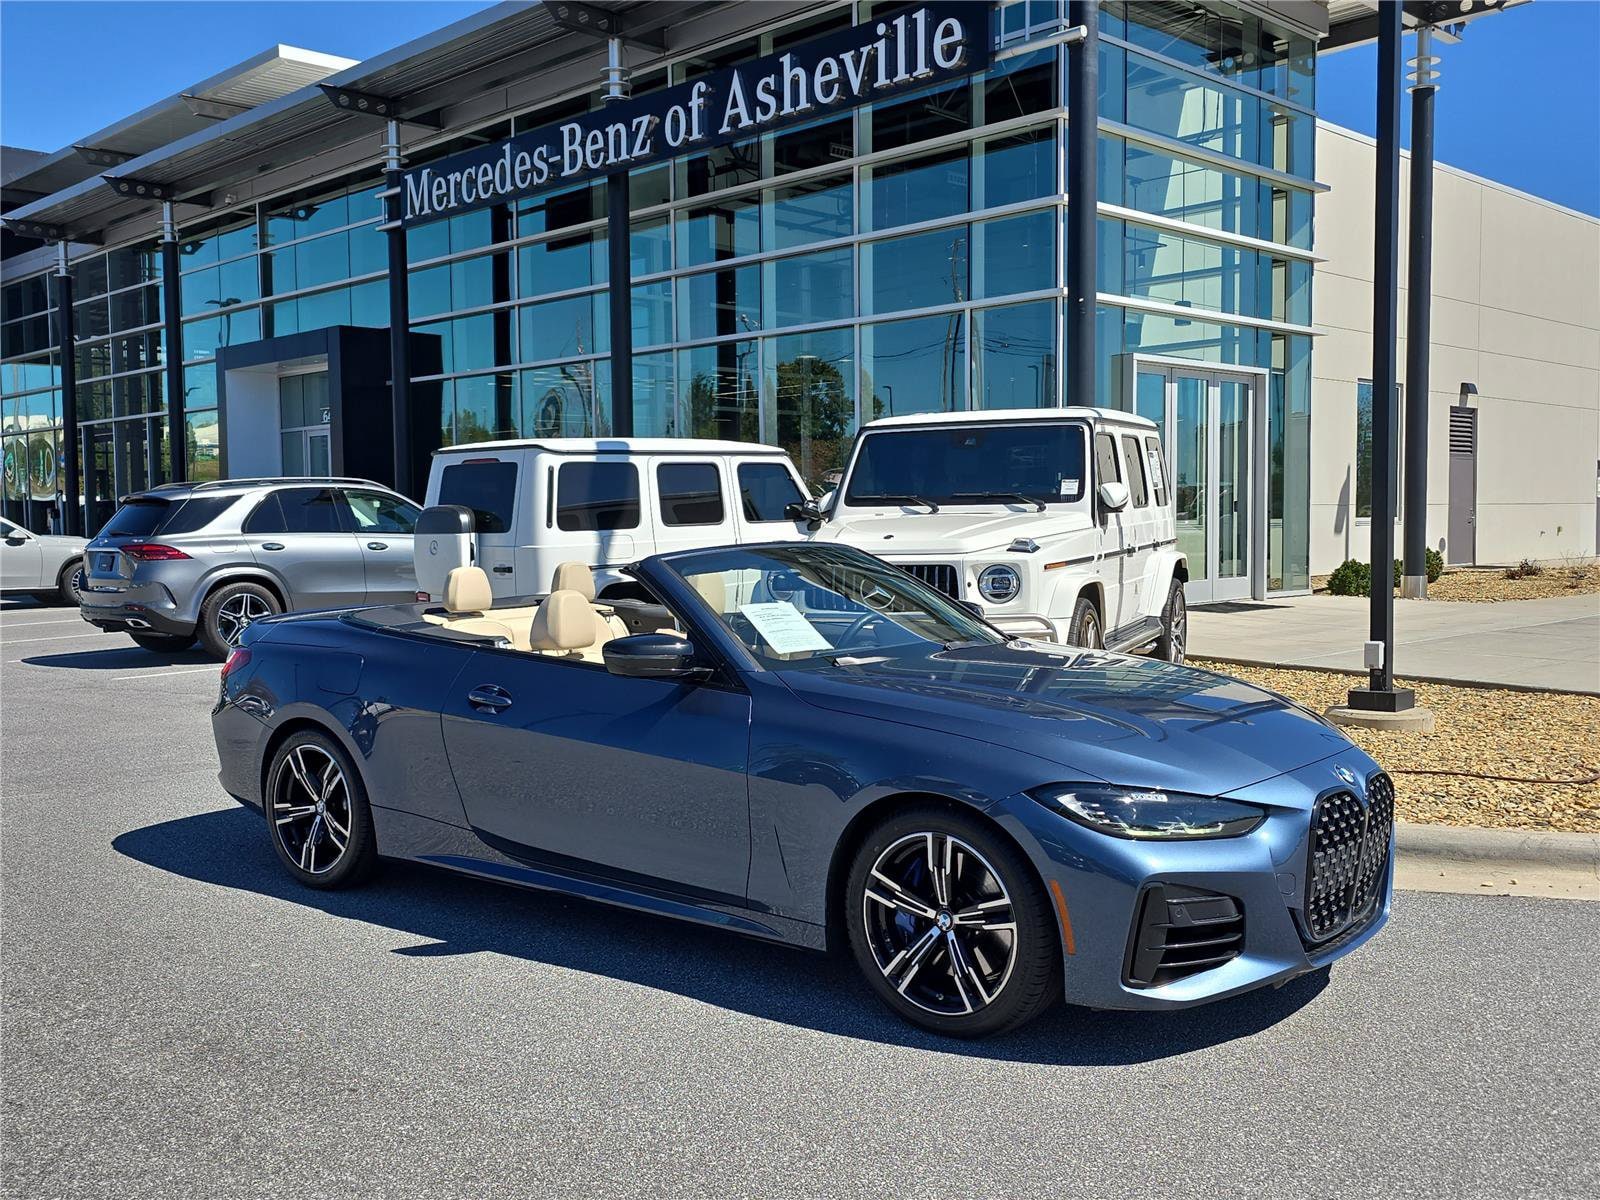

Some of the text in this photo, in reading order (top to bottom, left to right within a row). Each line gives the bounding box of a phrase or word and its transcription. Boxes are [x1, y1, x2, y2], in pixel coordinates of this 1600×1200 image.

[404, 7, 964, 220] Mercedes-Benz of Asheville
